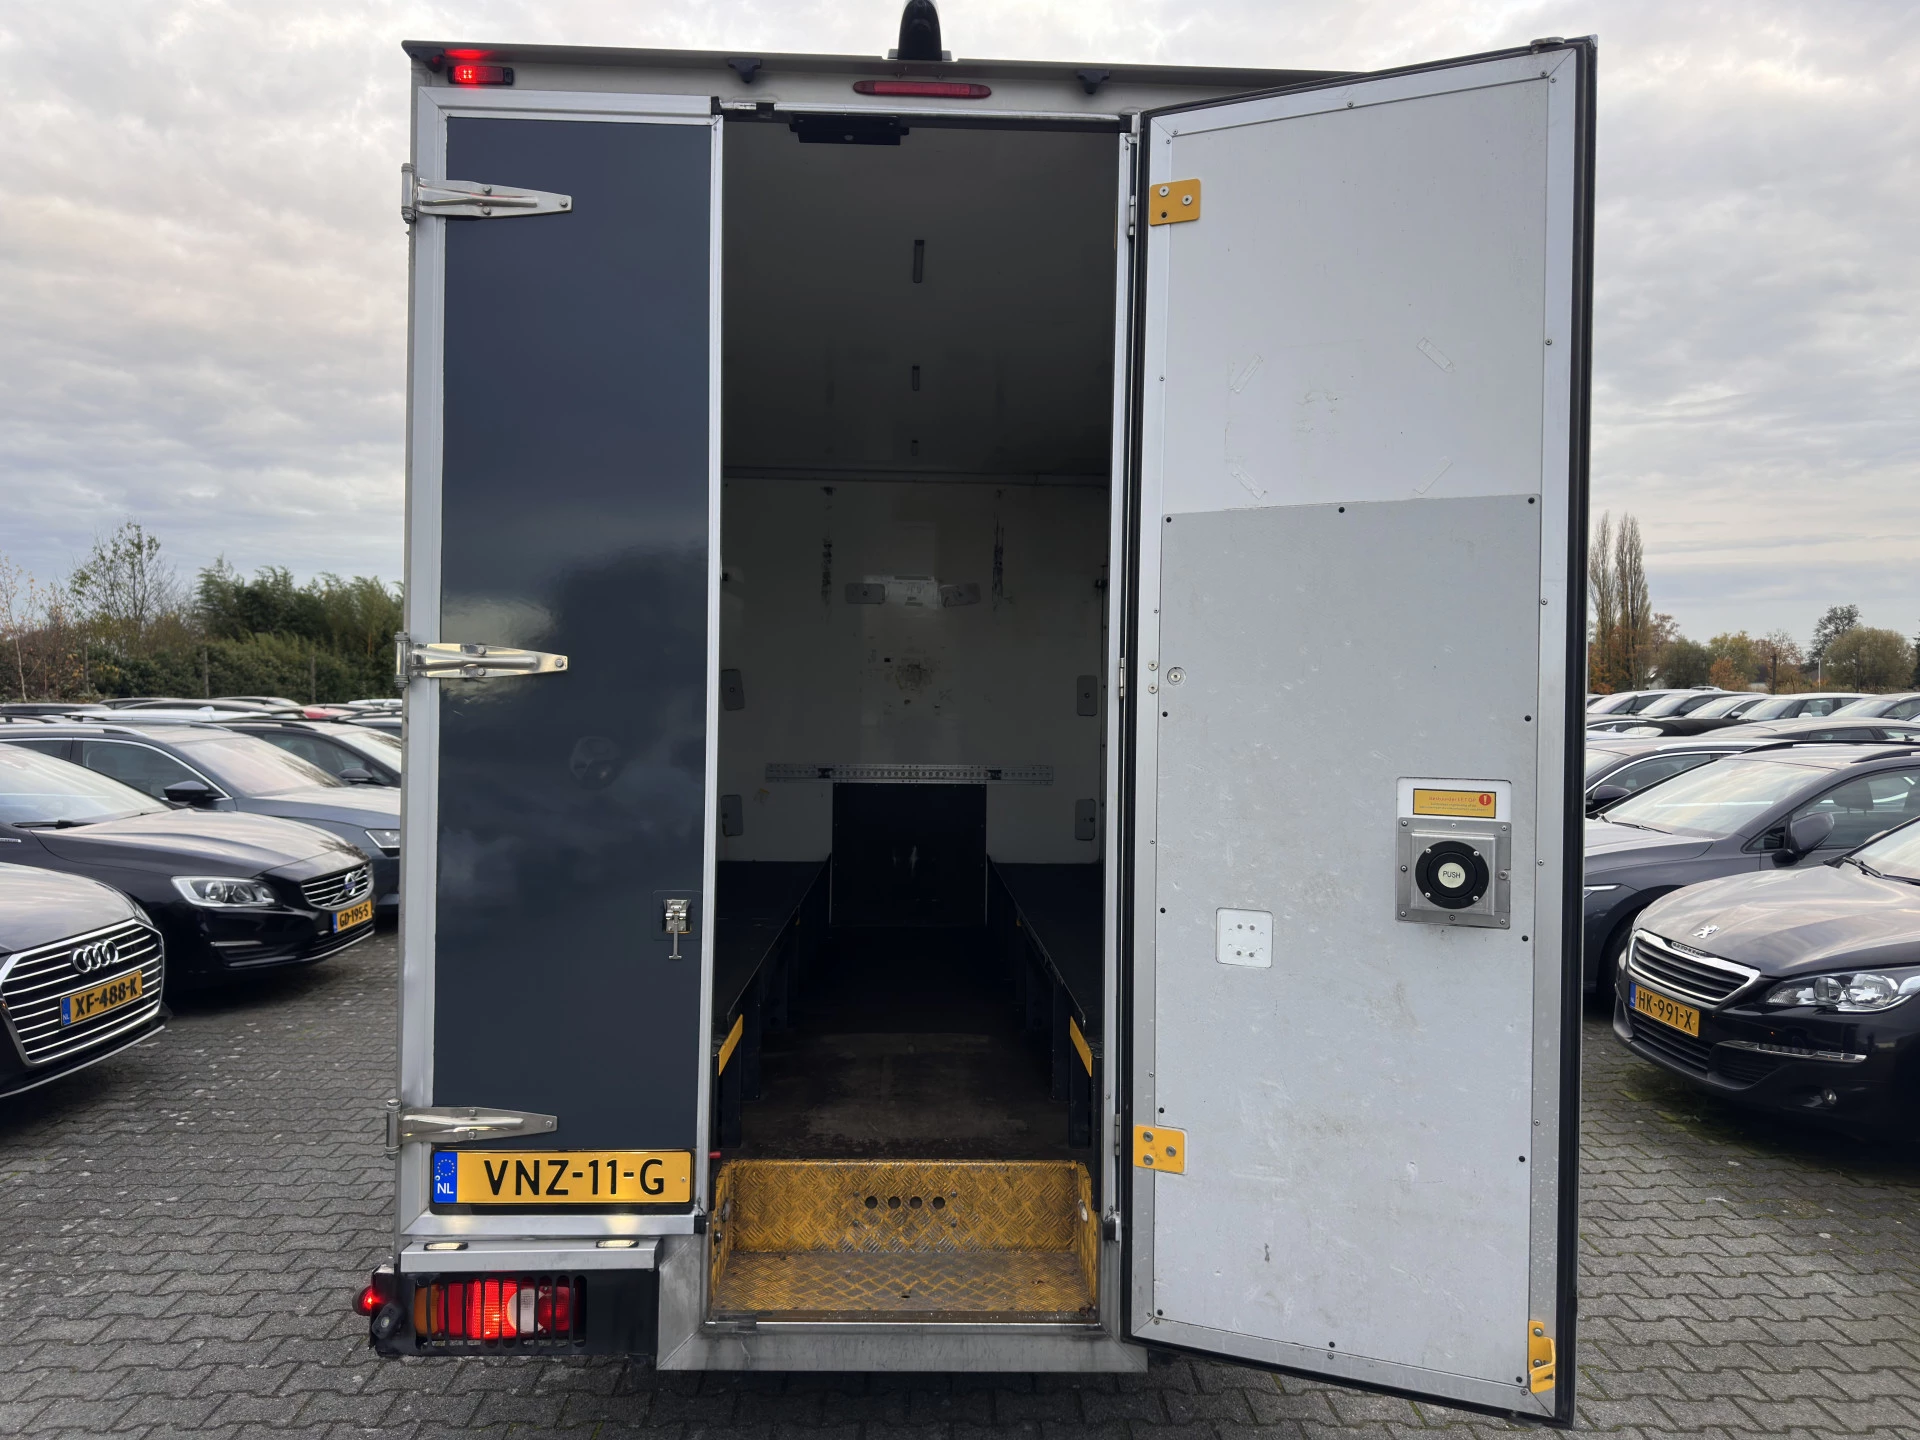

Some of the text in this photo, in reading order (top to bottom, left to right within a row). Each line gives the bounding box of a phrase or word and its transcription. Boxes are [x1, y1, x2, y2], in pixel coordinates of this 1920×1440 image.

[1442, 870, 1461, 879] PUSH
[339, 903, 369, 927] GD-195-S
[75, 976, 138, 1018] XF-488-K
[1638, 989, 1693, 1031] HK-991-X
[437, 1183, 454, 1194] NL
[484, 1159, 665, 1196] VNZ-11-G
